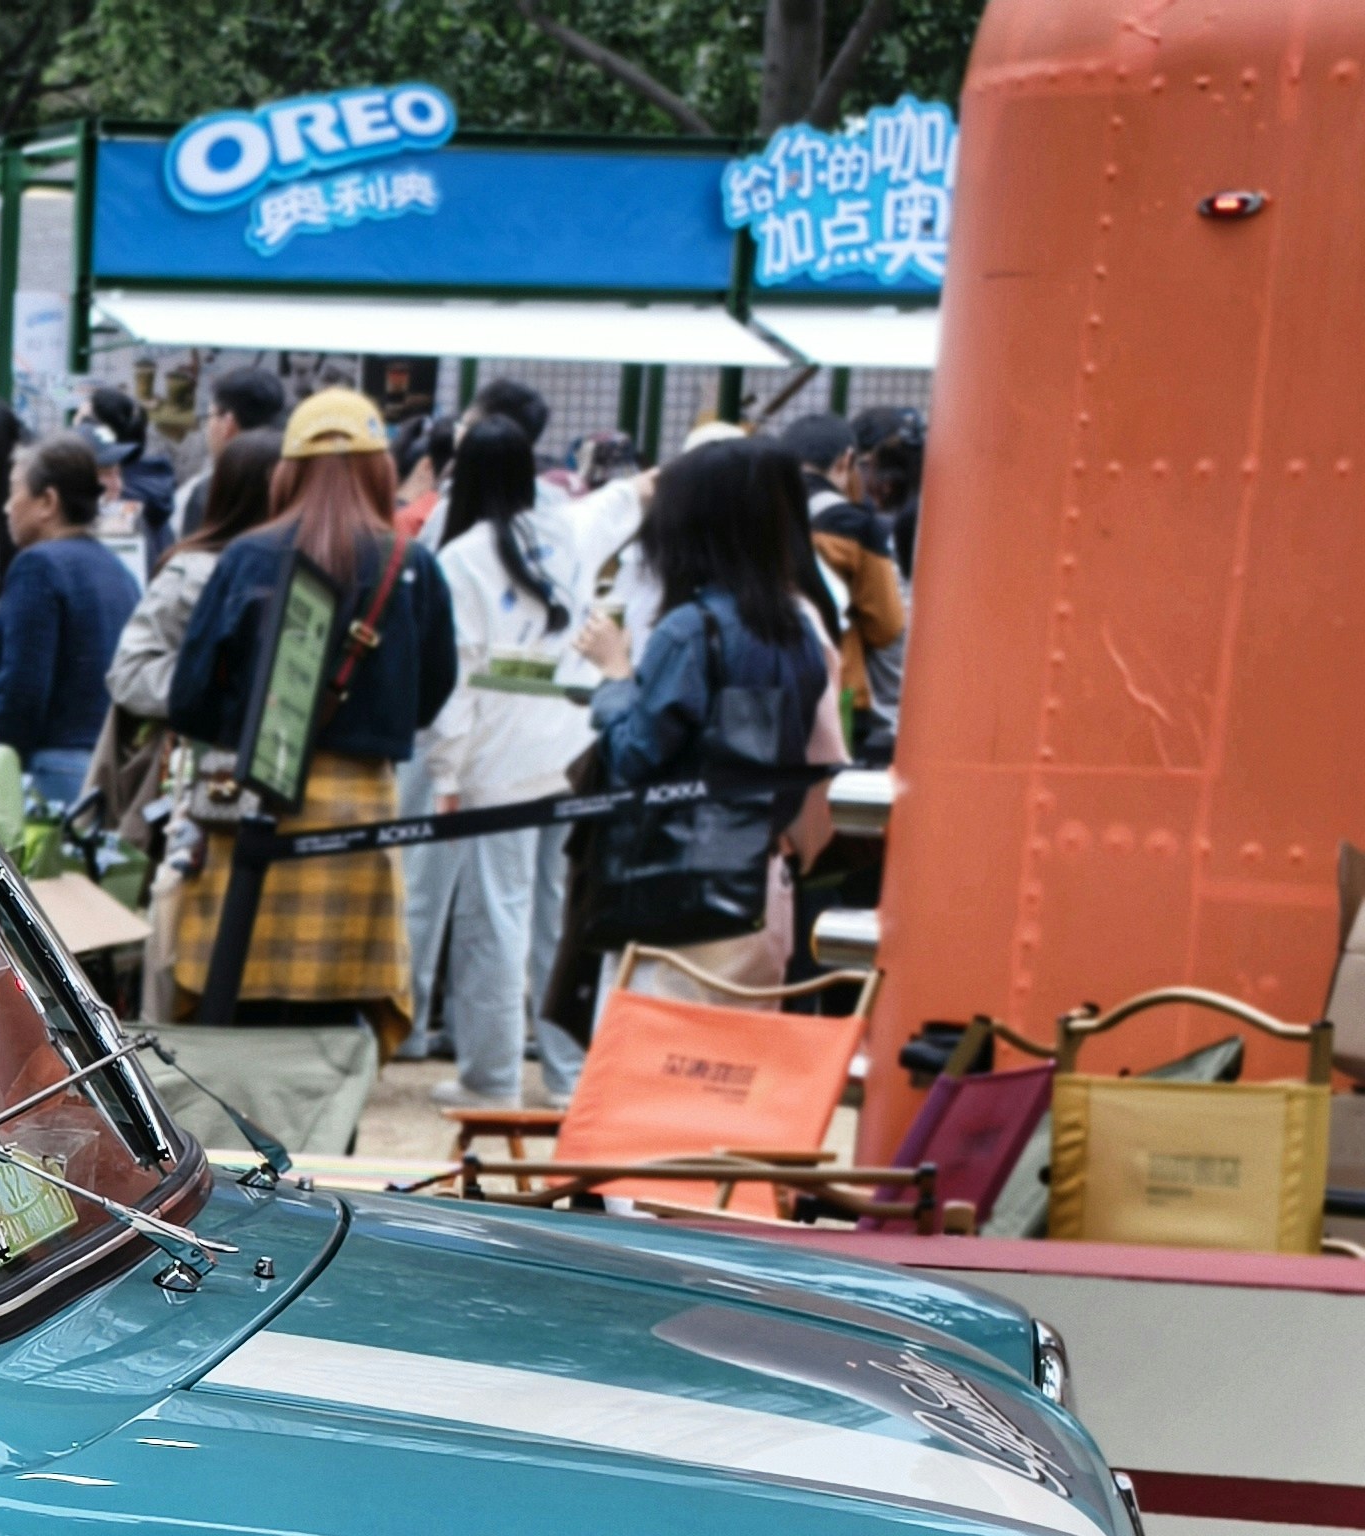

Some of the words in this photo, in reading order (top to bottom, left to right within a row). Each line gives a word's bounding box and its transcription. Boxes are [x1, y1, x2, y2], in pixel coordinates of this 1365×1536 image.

[174, 87, 449, 197] OREO
[729, 103, 961, 222] 给你的咖
[758, 180, 949, 278] 加点奥
